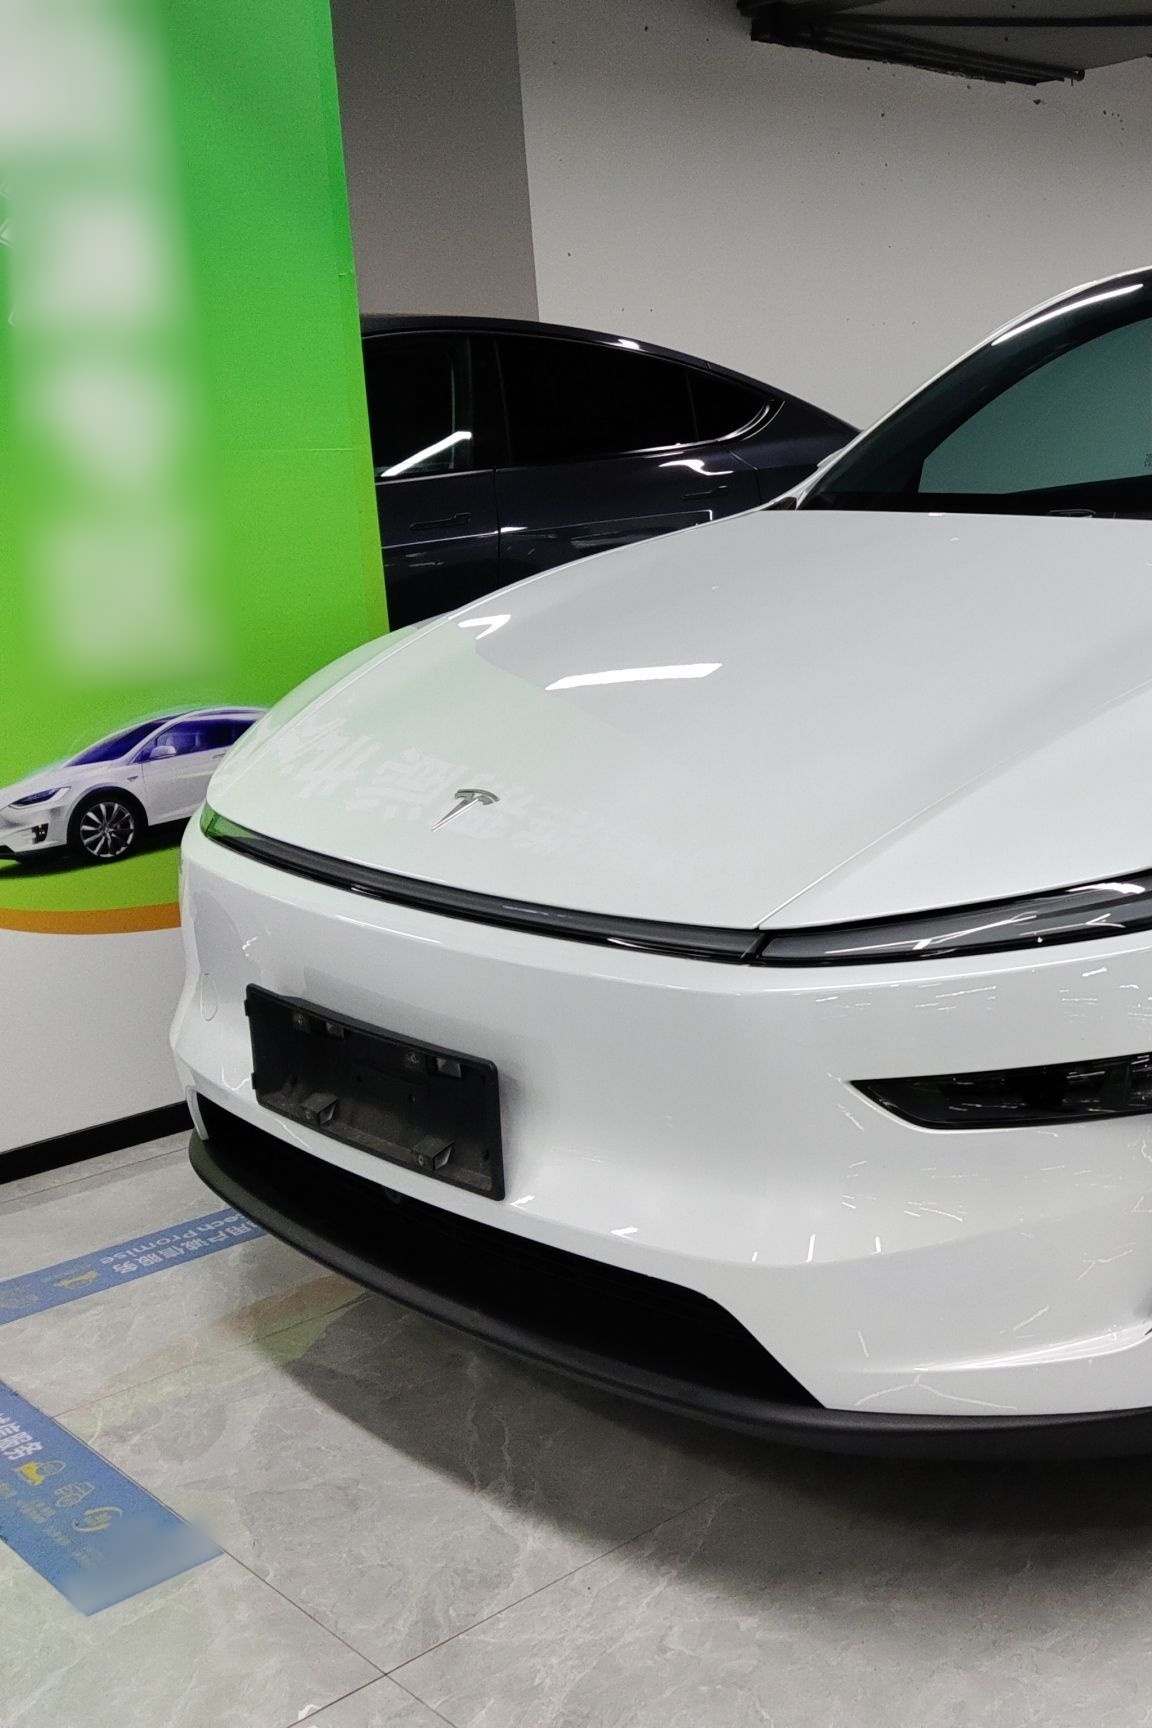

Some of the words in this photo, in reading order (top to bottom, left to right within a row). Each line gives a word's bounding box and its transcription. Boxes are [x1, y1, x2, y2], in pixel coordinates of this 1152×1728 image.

[100, 1229, 198, 1264] Promise
[112, 1219, 259, 1273] 用户诚信服务
